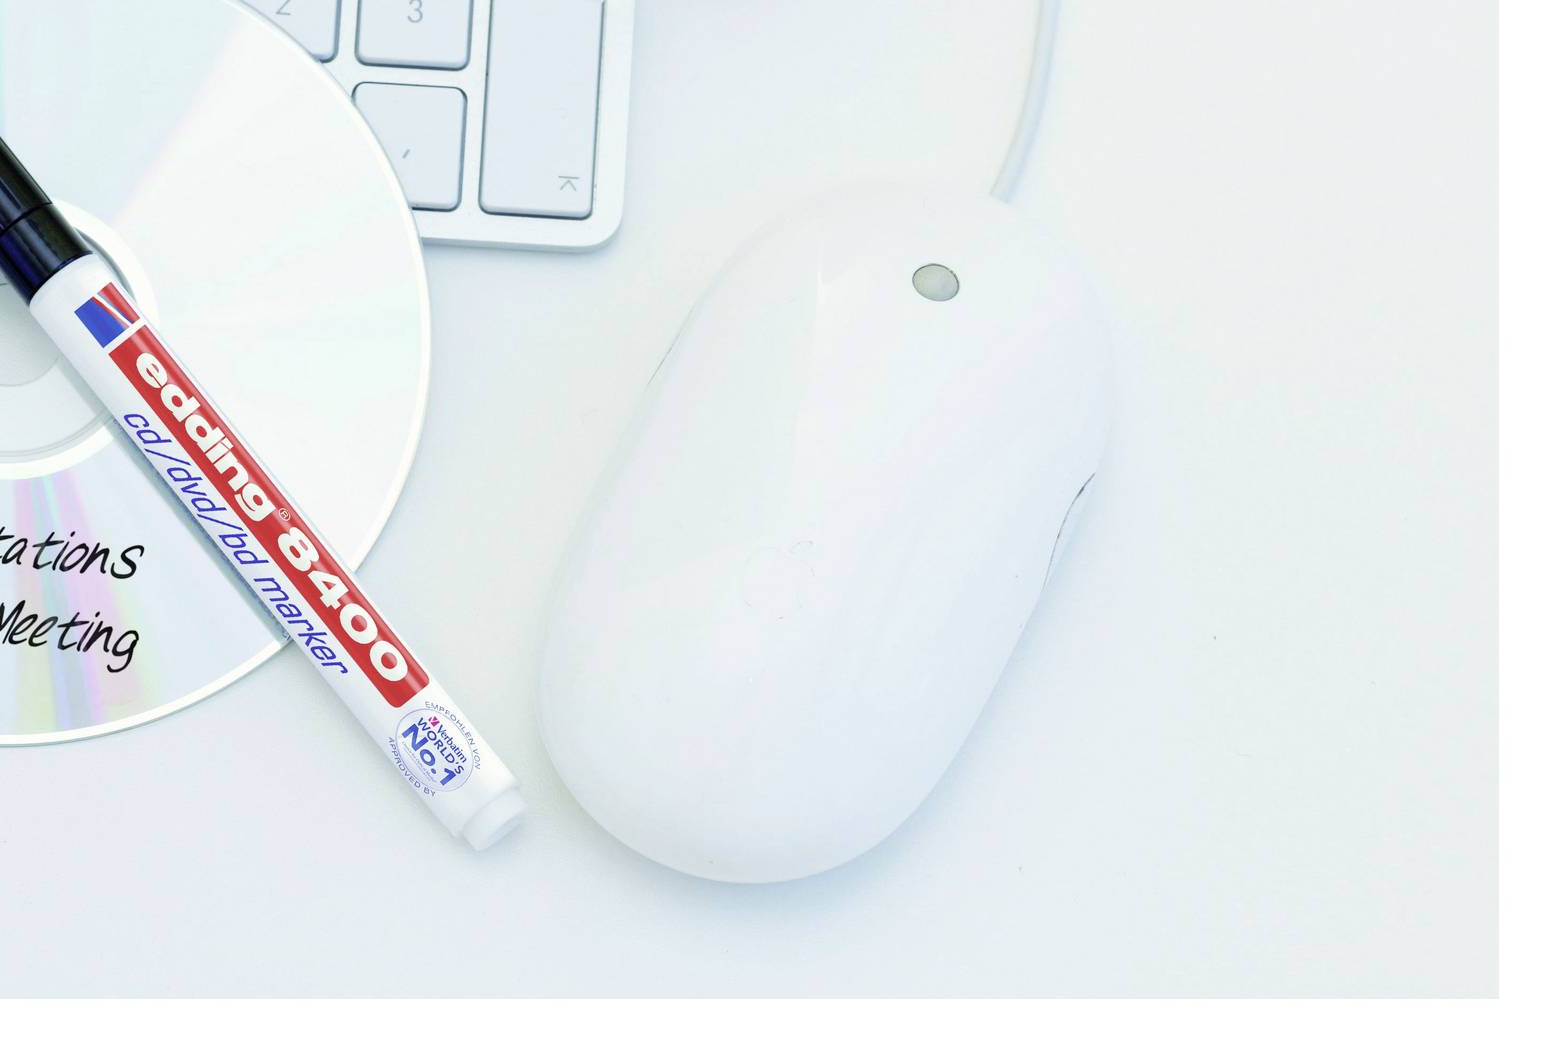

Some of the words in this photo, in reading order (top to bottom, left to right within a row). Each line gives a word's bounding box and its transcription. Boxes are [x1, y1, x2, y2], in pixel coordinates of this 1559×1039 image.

[122, 413, 270, 565] cd/dvd/bd
[254, 577, 349, 674] marker
[136, 351, 276, 523] edding
[277, 527, 408, 682] 8400
[388, 736, 421, 789] APPROVED
[423, 786, 436, 797] BY
[401, 723, 457, 787] No.1
[417, 716, 465, 775] WORLD'S
[425, 701, 476, 746] EMPFOHLEN
[472, 747, 481, 770] VON
[437, 724, 468, 764] Verbatim
